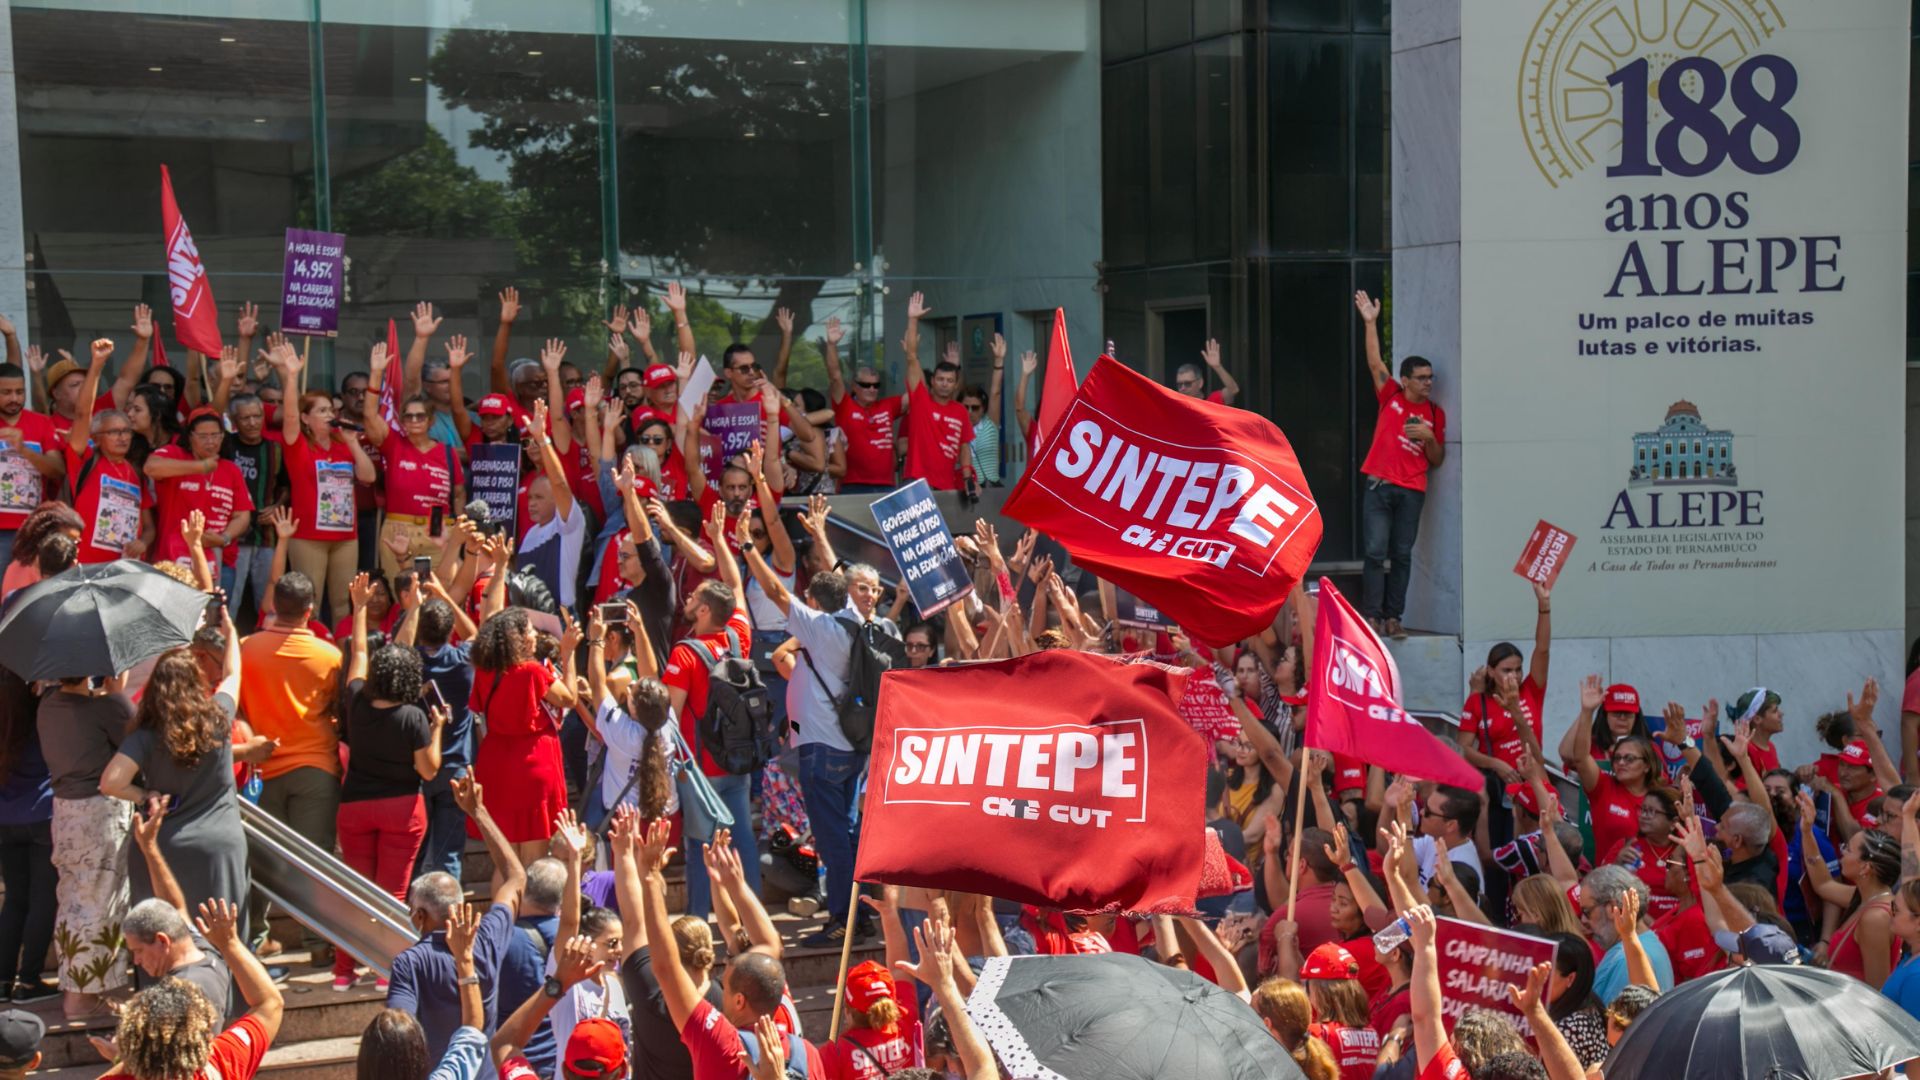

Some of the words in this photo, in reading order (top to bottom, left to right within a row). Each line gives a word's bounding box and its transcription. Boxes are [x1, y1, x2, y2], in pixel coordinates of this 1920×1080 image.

[1606, 54, 1800, 177] 188
[1605, 191, 1749, 232] anos
[288, 242, 294, 253] A
[295, 243, 315, 256] HORA
[293, 260, 333, 279] 14,95%
[1603, 236, 1845, 298] ALEPE
[286, 294, 297, 306] DA
[290, 282, 301, 293] NA
[302, 283, 334, 296] CARREIRA
[1578, 313, 1617, 330] Um
[1626, 311, 1690, 333] palco
[1698, 310, 1726, 327] de
[1735, 308, 1814, 326] muitas
[1578, 339, 1637, 356] lutas
[1645, 341, 1659, 354] e
[1666, 335, 1762, 354] vitórias.
[712, 418, 730, 427] HORA
[491, 476, 496, 487] O
[498, 476, 514, 488] PISO
[1055, 419, 1299, 548] SINTEPE
[1600, 488, 1765, 529] ALEPE
[892, 525, 920, 548] PAGUE
[919, 521, 926, 533] O
[924, 514, 940, 532] PISO
[1600, 533, 1669, 544] ASSEMBLEIA
[1672, 532, 1742, 543] LEGISLATIVA
[1746, 531, 1764, 541] DO
[902, 548, 917, 562] NA
[916, 530, 948, 556] CARREIRA
[1175, 537, 1230, 563] CUT
[1534, 532, 1568, 581] REVOGA
[1608, 546, 1652, 556] ESTADO
[1656, 545, 1672, 555] DE
[1675, 544, 1757, 554] PERNAMBUCO
[906, 565, 922, 580] DA
[1588, 562, 1597, 572] A
[1600, 561, 1626, 572] Casa
[1630, 560, 1642, 572] de
[1646, 560, 1676, 571] Todos
[1679, 562, 1689, 570] os
[1693, 558, 1777, 570] Pernambucanos
[894, 732, 1137, 798] SINTEPE
[982, 796, 1040, 821] CNTE
[1049, 804, 1112, 829] CUT
[1445, 940, 1534, 974] CAMPANHA
[1340, 1030, 1379, 1048] SINTEPE
